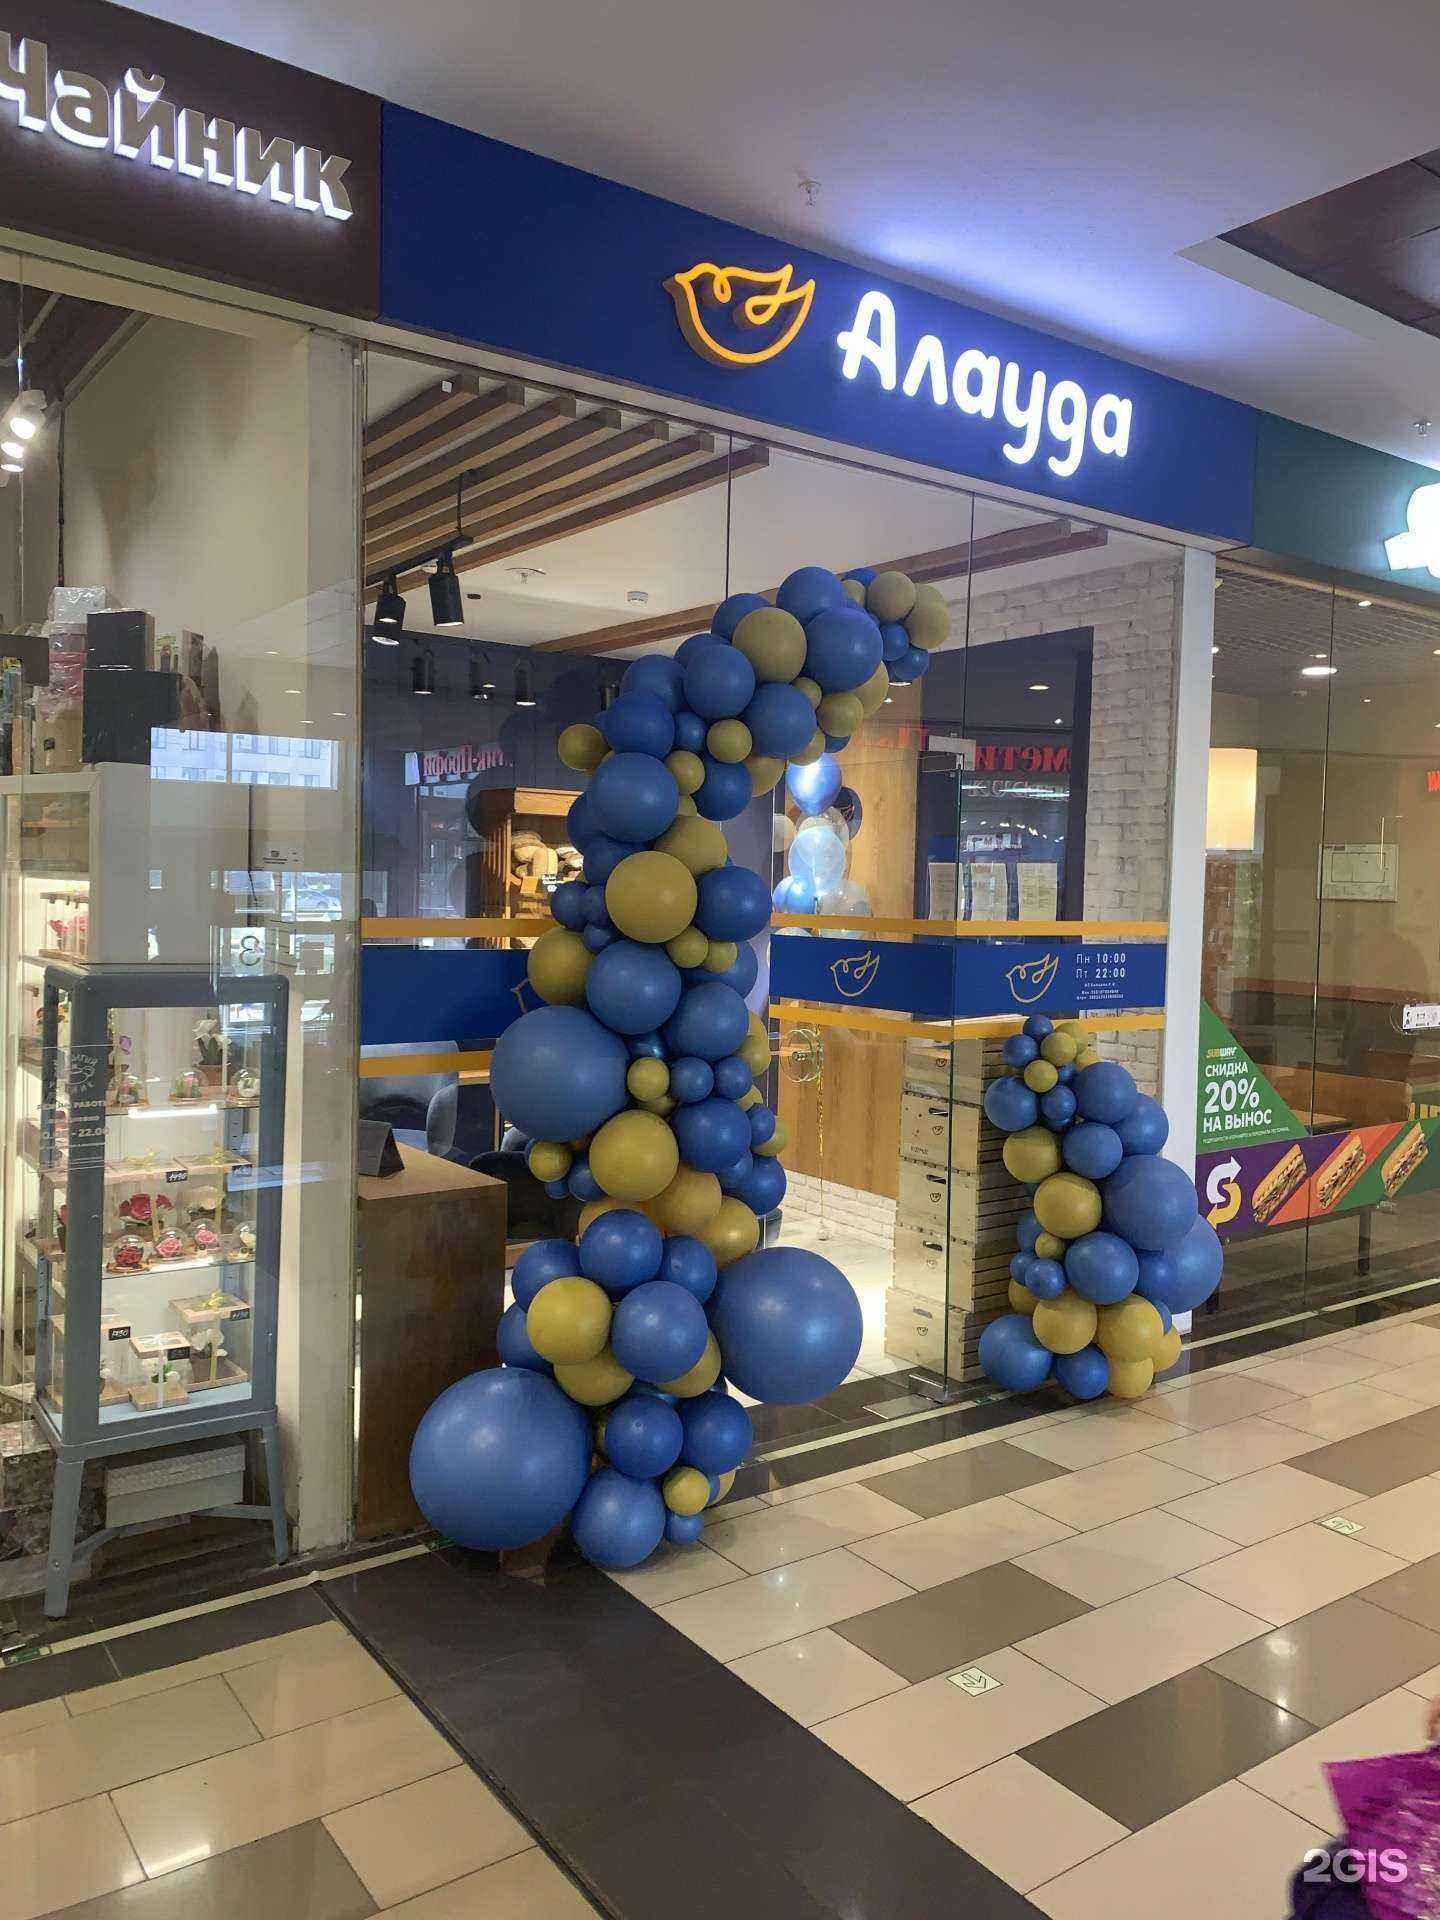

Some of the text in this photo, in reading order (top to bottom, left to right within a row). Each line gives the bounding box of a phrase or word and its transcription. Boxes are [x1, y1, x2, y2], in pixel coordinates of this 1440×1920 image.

[0, 31, 352, 221] Чайник
[836, 290, 1133, 477] Алауда
[1076, 952, 1126, 964] Пн 10:00
[1095, 967, 1126, 979] 22:00
[1206, 1046, 1237, 1059] SUBWAY
[1205, 1062, 1248, 1077] СКИДКА
[1204, 1077, 1260, 1113] 20%
[1203, 1108, 1273, 1133] НА ВЫНОС
